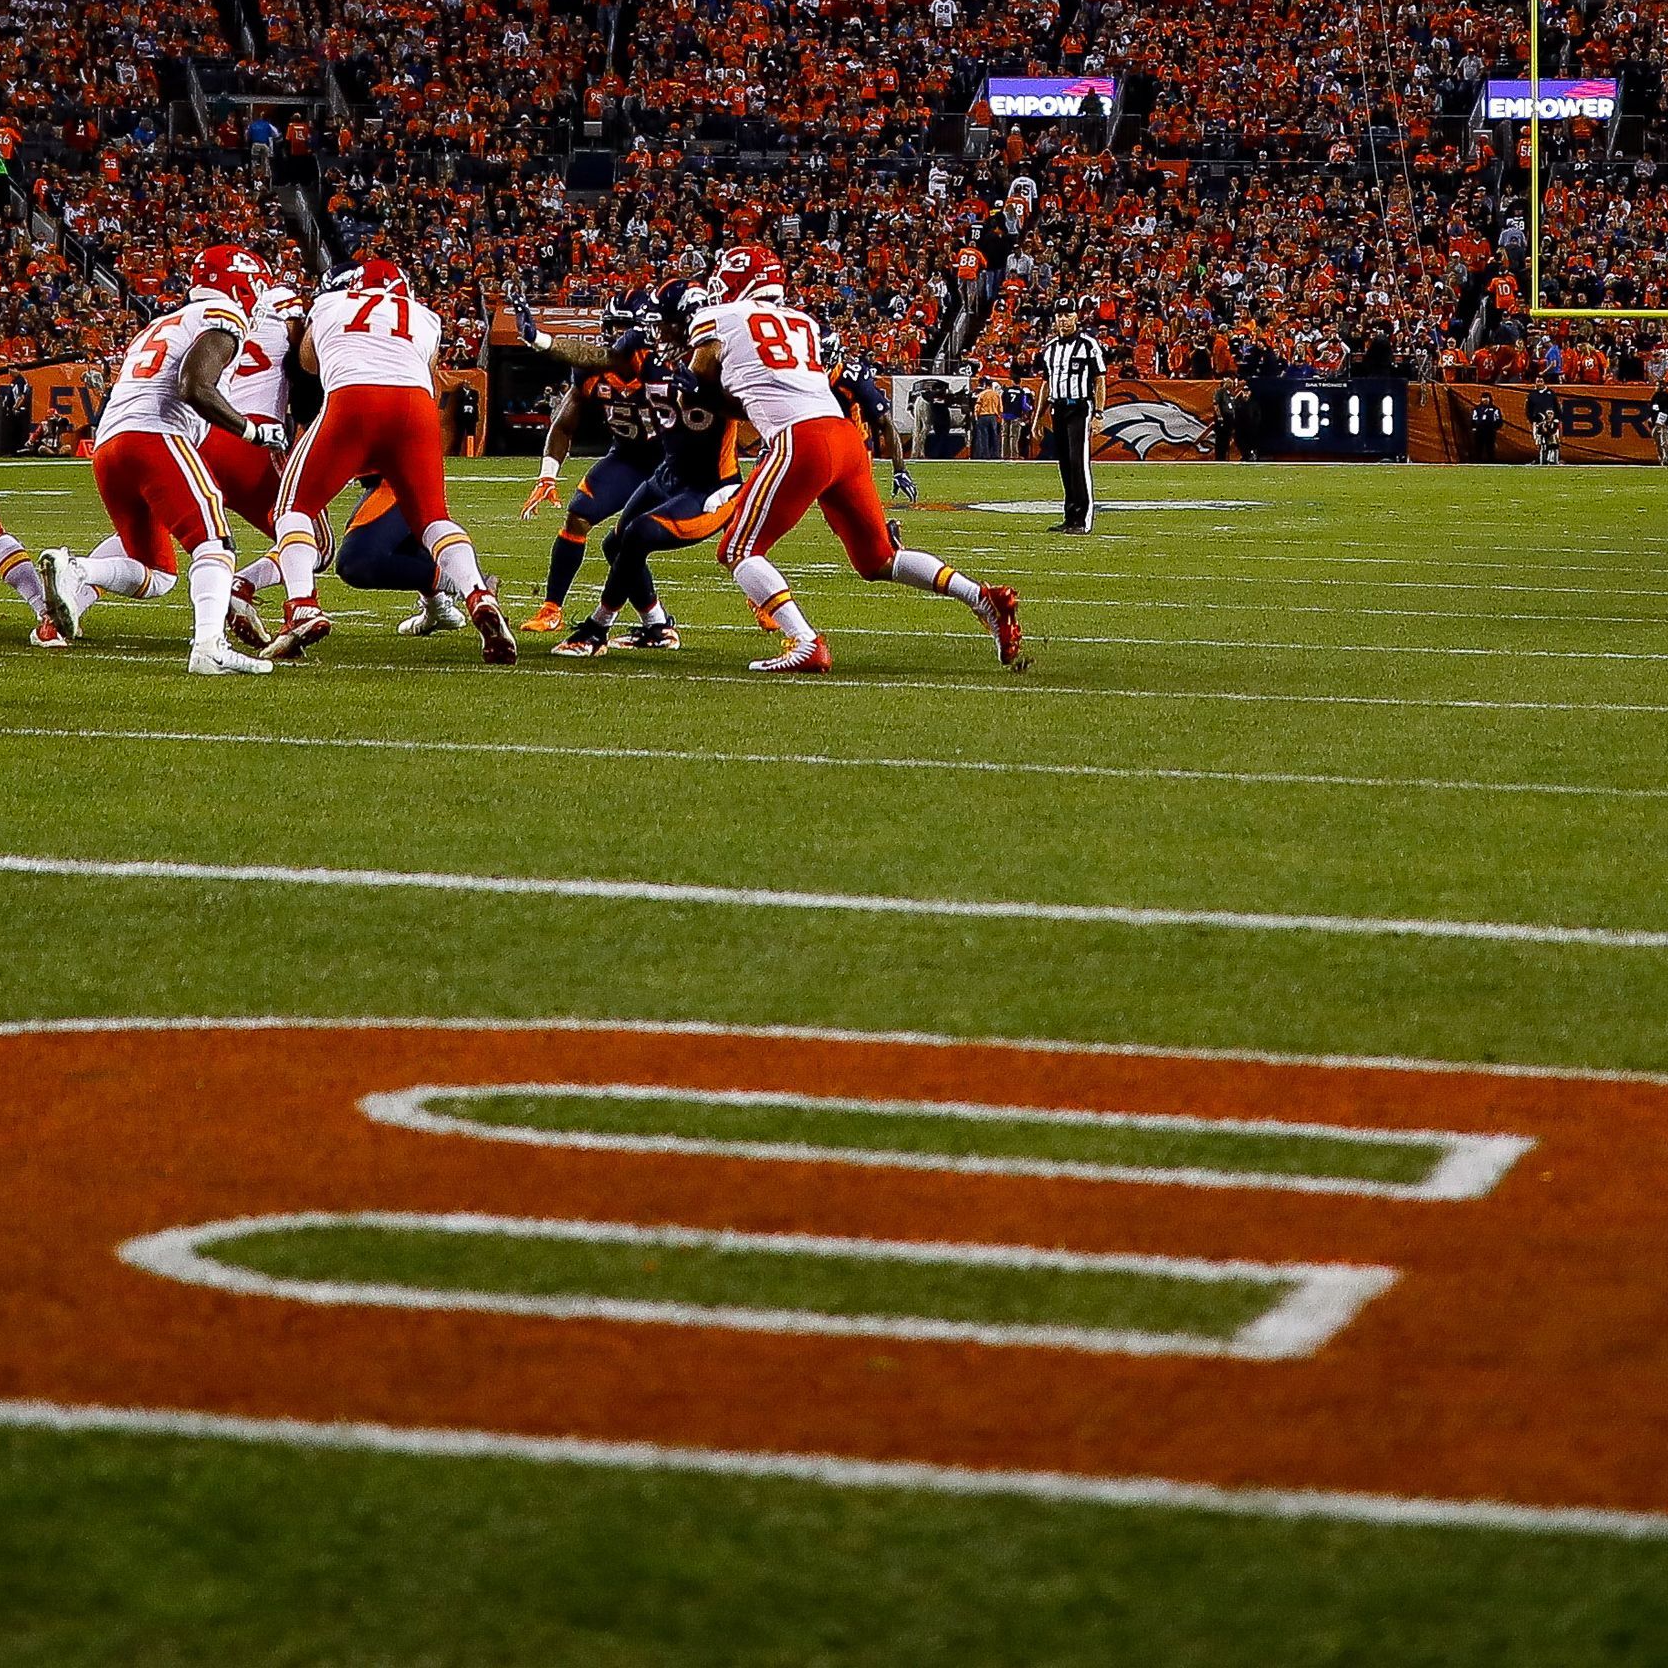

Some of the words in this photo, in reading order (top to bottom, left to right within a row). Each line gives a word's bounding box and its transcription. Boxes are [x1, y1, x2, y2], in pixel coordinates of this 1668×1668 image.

[343, 291, 417, 341] 71
[747, 313, 825, 373] 87
[843, 361, 863, 383] 26
[645, 382, 715, 432] 56
[1290, 391, 1394, 438] 0:11
